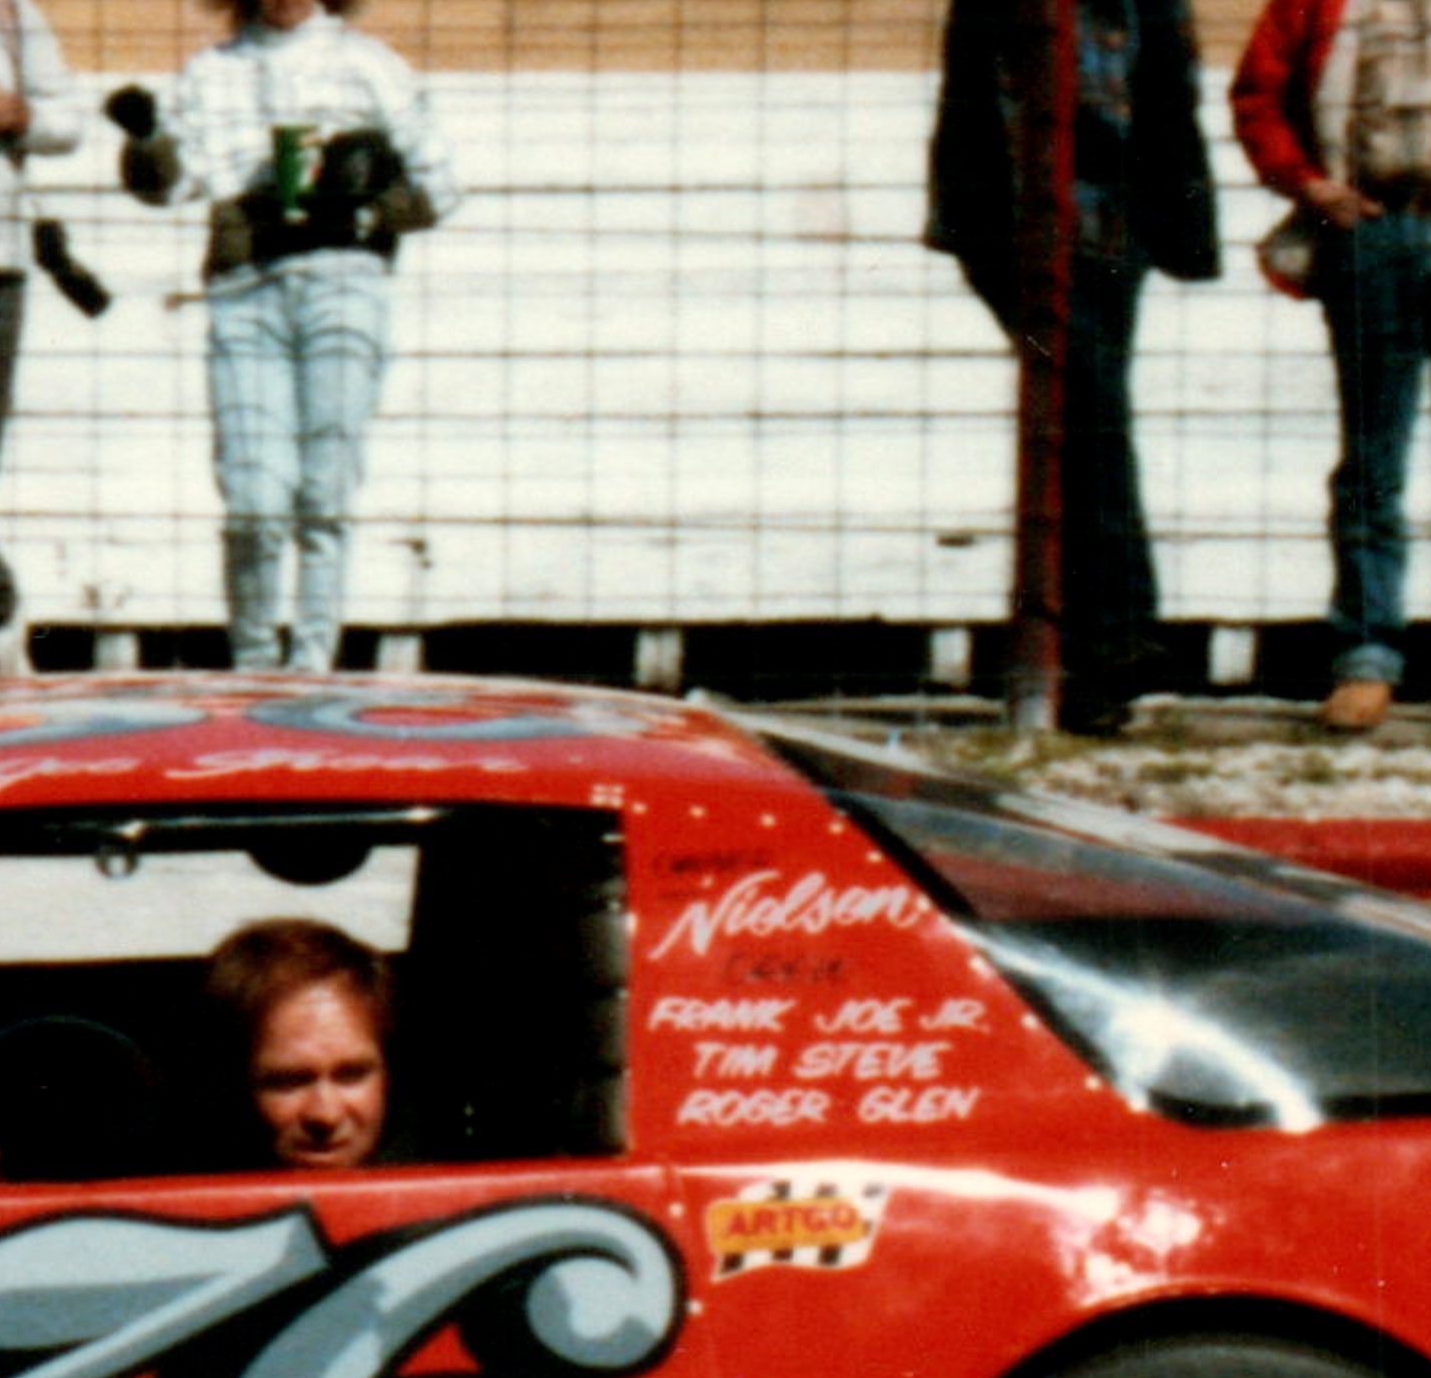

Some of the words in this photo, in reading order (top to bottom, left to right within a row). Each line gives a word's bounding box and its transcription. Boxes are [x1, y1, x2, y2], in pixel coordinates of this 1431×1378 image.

[648, 996, 796, 1032] FRANK
[814, 997, 913, 1033] JOE
[693, 1041, 780, 1078] TIM
[793, 1041, 953, 1079] STEVE
[676, 1089, 831, 1126] ROGER
[857, 1086, 980, 1122] GLEN
